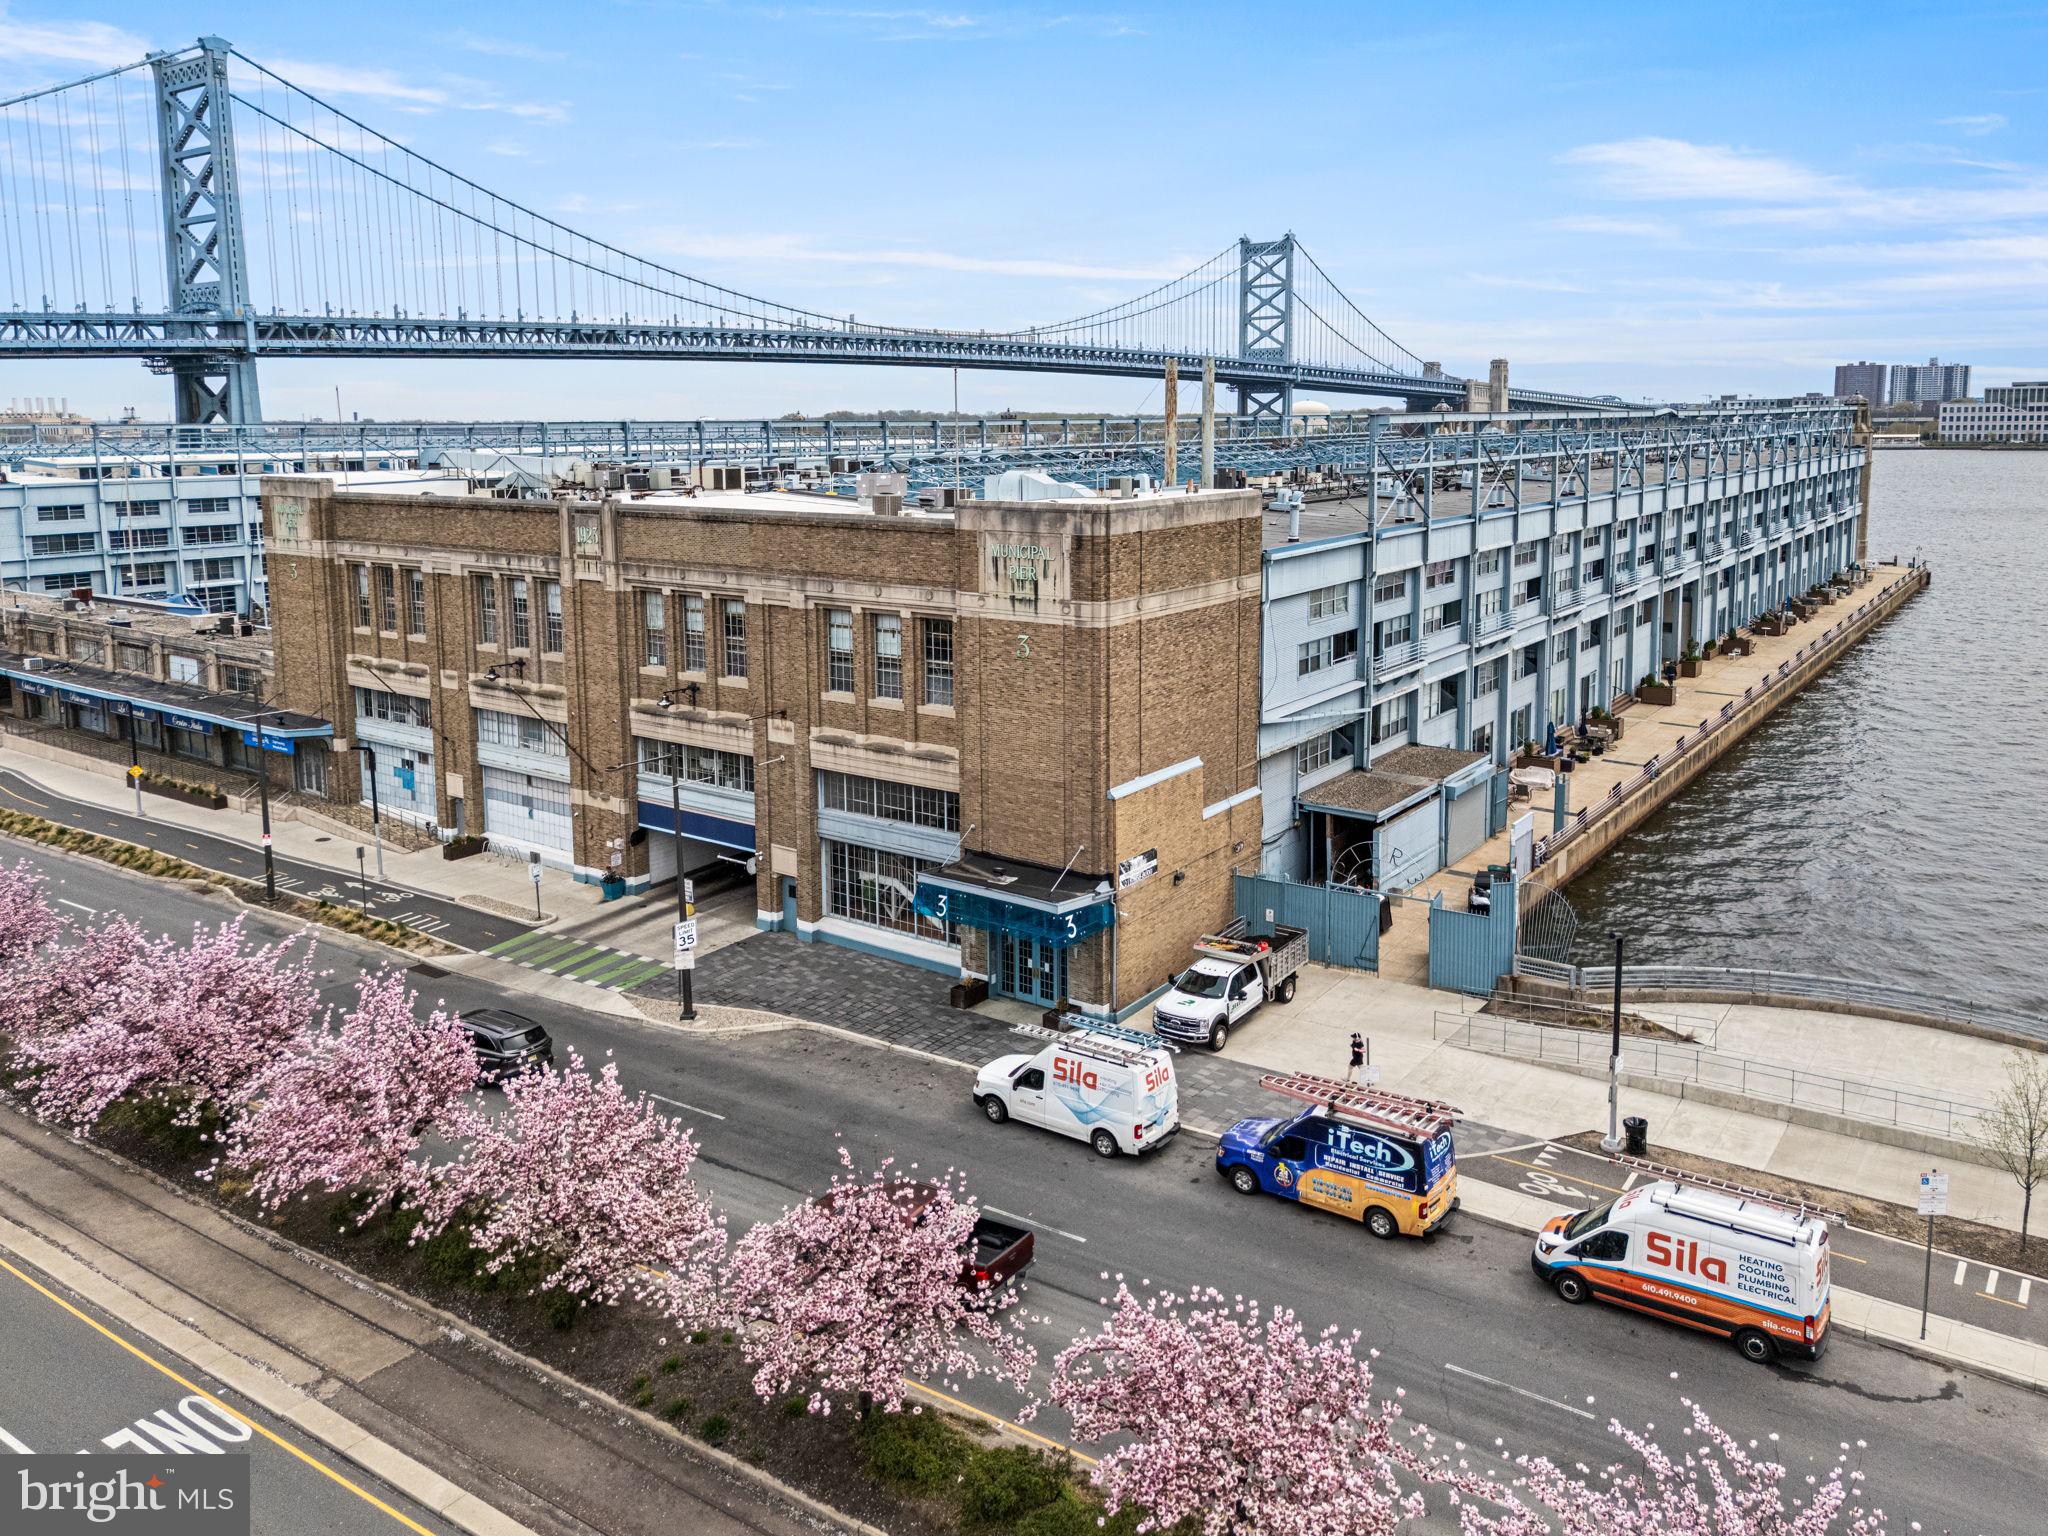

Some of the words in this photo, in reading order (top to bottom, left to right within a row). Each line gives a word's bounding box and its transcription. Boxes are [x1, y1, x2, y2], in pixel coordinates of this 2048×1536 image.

[576, 526, 599, 545] 1923
[991, 543, 1057, 561] MUNICIPAL
[290, 563, 298, 580] 3
[1008, 565, 1038, 581] PIER
[1016, 634, 1031, 659] 3
[936, 894, 948, 917] 3
[677, 922, 695, 931] SPEED
[679, 928, 693, 936] LIMIT
[1065, 914, 1077, 939] 3
[679, 934, 695, 947] 35
[1053, 1056, 1098, 1090] Sila
[1145, 1067, 1170, 1092] Sila
[1328, 1128, 1392, 1163] iTech
[1429, 1137, 1448, 1158] iTech
[1323, 1154, 1346, 1166] REPAIR
[1349, 1161, 1374, 1174] INSTALL
[1378, 1170, 1405, 1182] SERVICE
[1330, 1147, 1359, 1161] Electrical
[1359, 1156, 1386, 1168] Services
[1325, 1161, 1360, 1176] Residential
[1365, 1173, 1404, 1188] Commercial
[1646, 1231, 1727, 1285] Sila
[1739, 1254, 1783, 1272] HEATING
[1738, 1273, 1790, 1293] PLUMBING
[1739, 1264, 1785, 1282] COOLING
[1642, 1283, 1697, 1305] 610.491.9400
[1737, 1283, 1797, 1305] ELECTRICAL
[1762, 1319, 1801, 1337] sila.com
[75, 1396, 252, 1454] ONL
